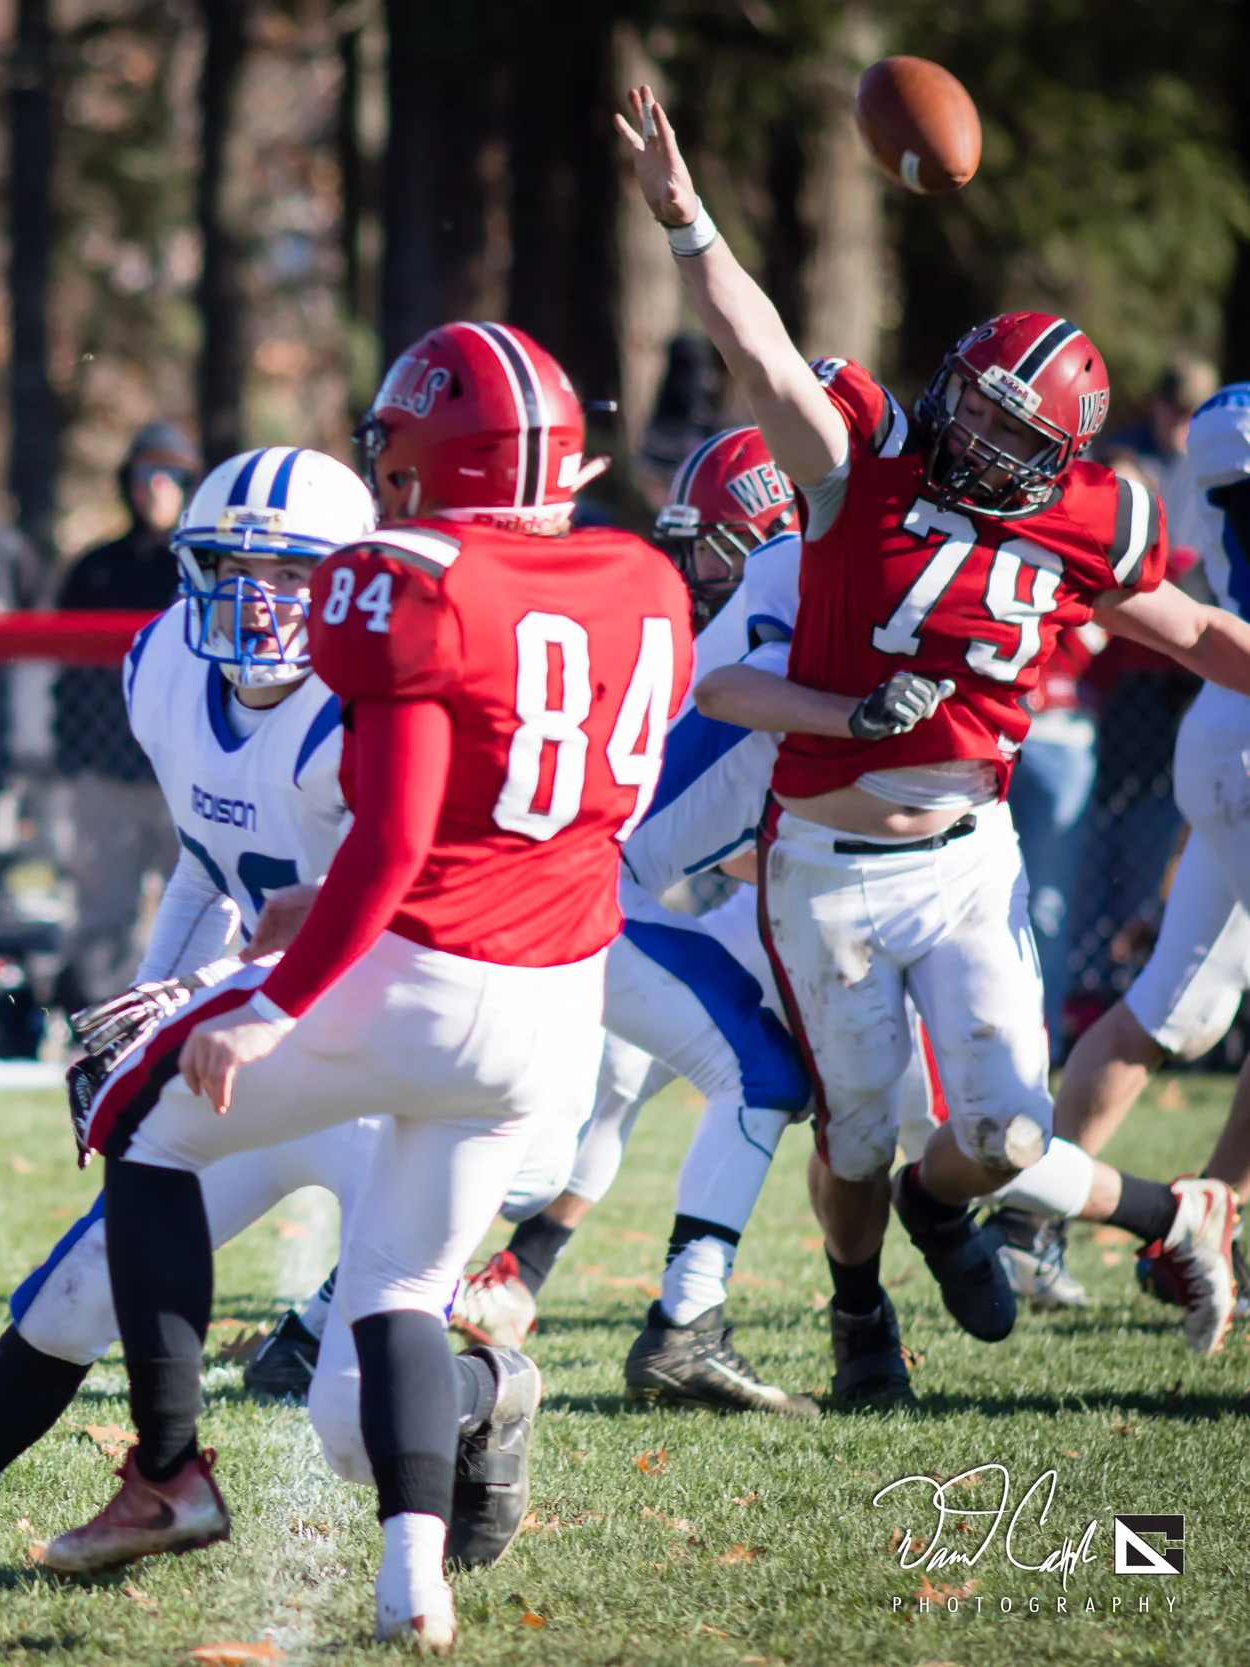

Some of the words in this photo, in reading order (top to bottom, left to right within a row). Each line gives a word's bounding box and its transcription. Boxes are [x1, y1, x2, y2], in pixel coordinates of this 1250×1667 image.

[322, 566, 393, 633] 84
[872, 497, 1064, 683] 79
[492, 610, 674, 843] 84
